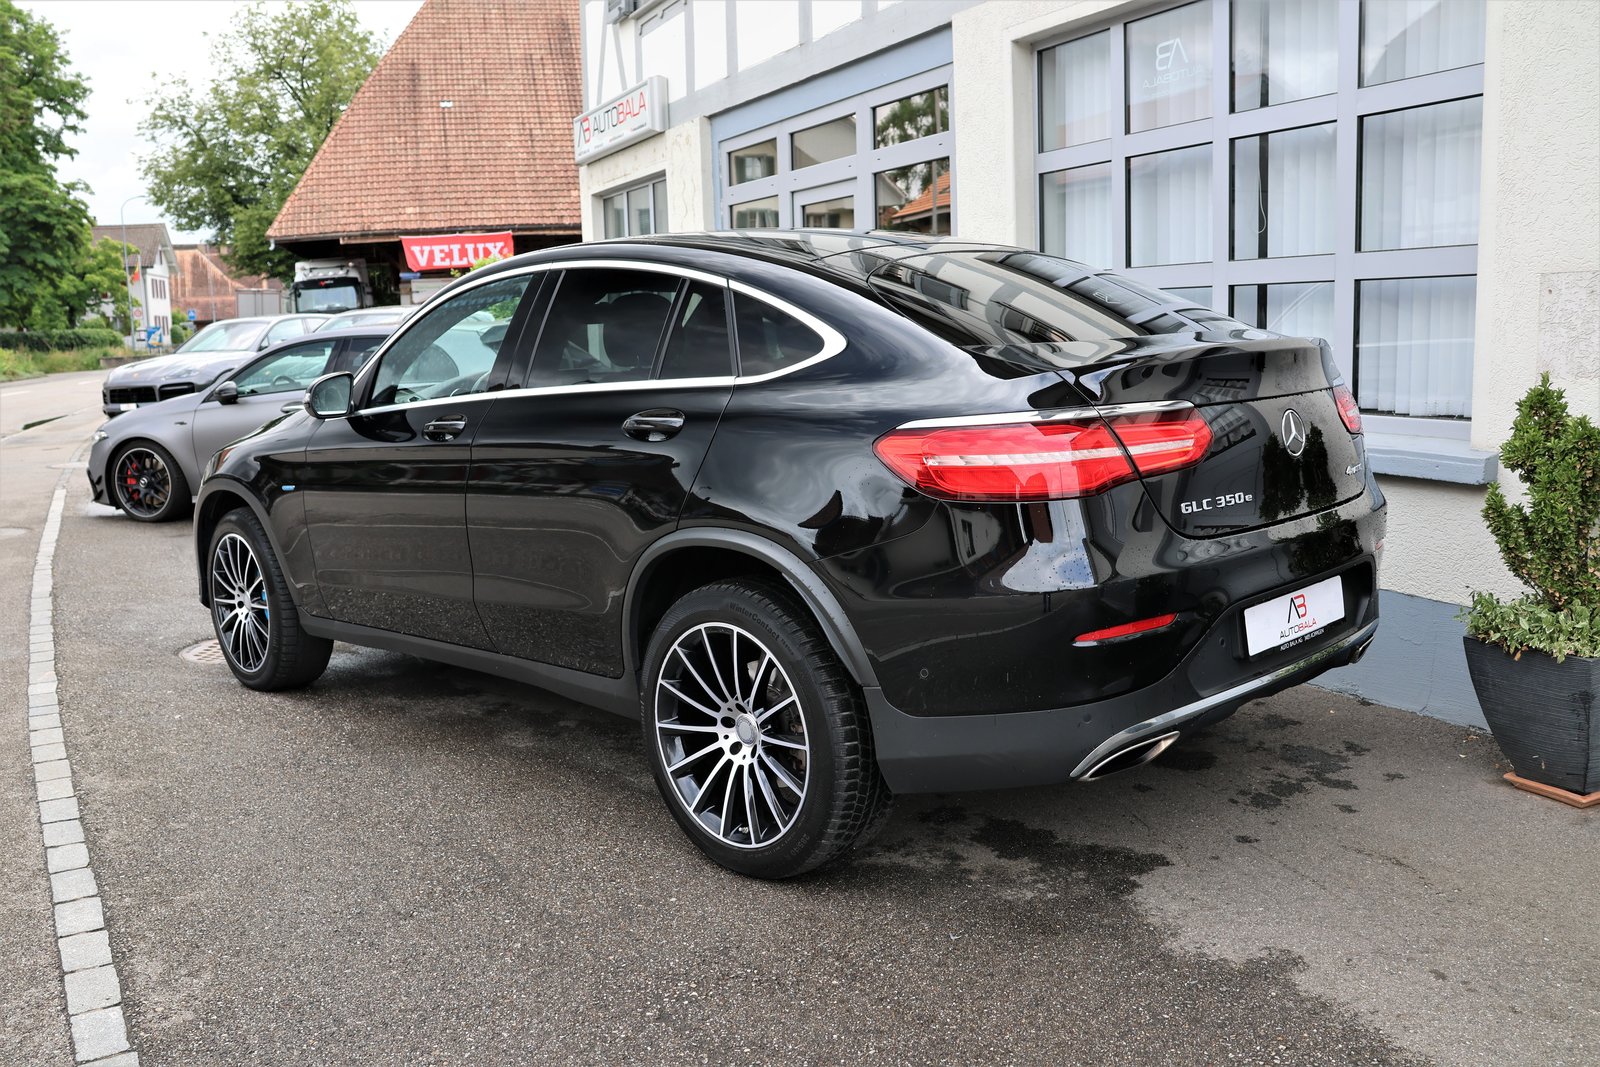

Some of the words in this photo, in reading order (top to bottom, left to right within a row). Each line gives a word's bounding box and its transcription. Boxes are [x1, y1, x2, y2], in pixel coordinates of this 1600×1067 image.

[592, 91, 647, 136] AUTOBALA
[411, 242, 505, 267] VELUX
[1181, 499, 1212, 514] GLC
[1215, 493, 1253, 508] 350e
[729, 601, 780, 641] WinterContact
[1279, 618, 1317, 640] AUTOBALA
